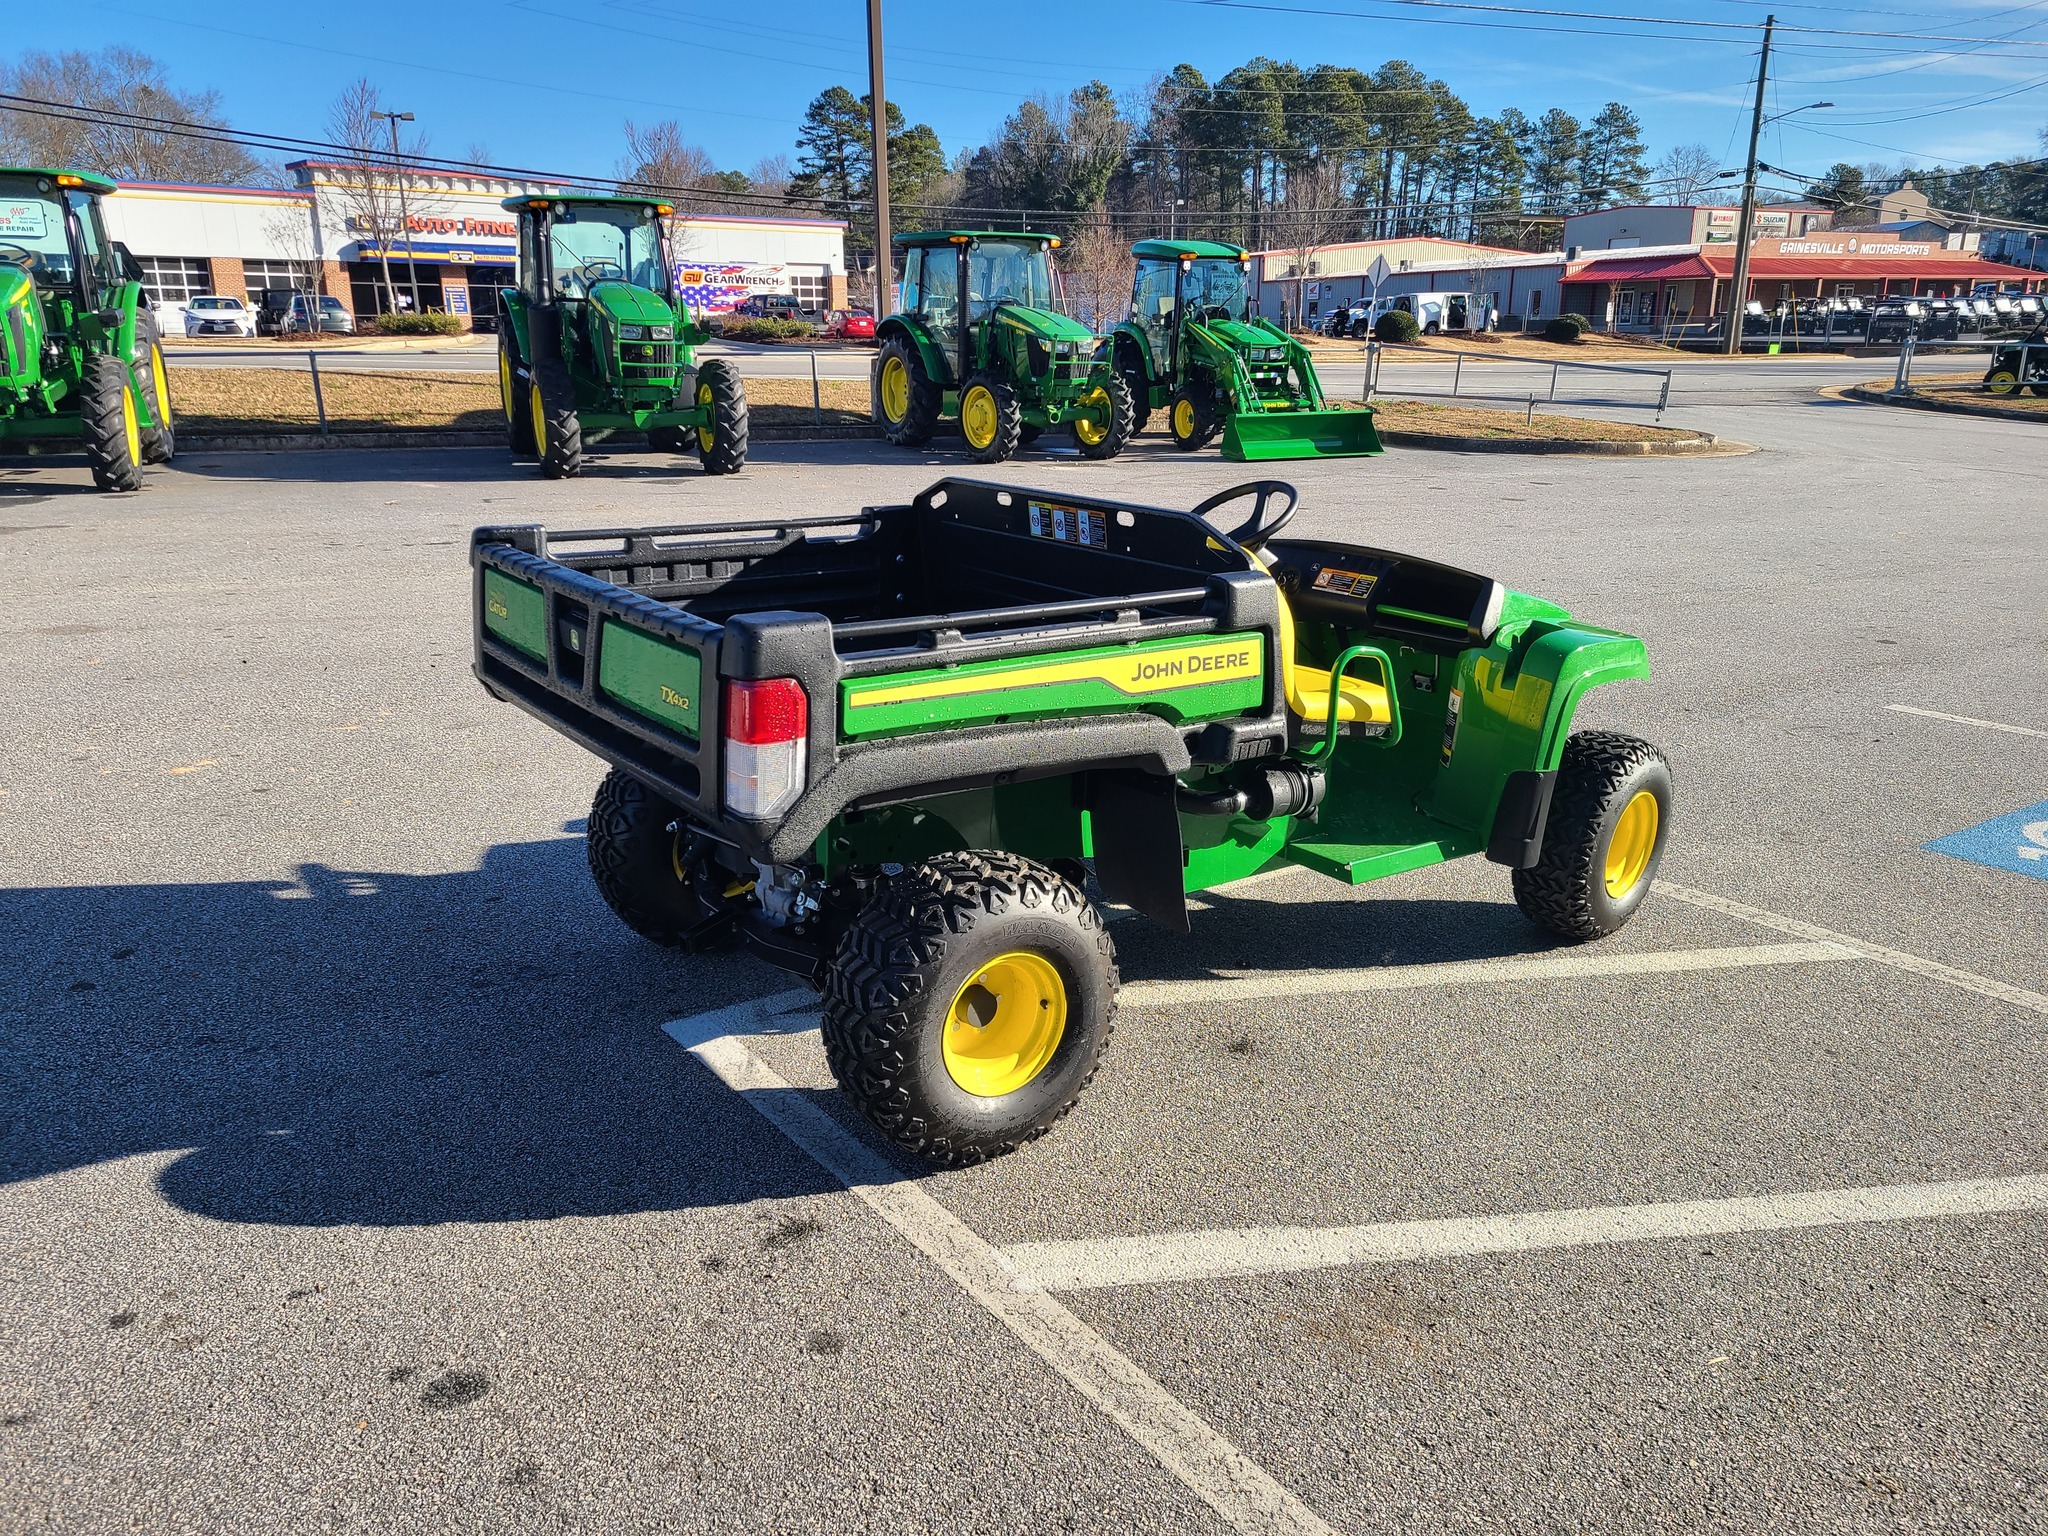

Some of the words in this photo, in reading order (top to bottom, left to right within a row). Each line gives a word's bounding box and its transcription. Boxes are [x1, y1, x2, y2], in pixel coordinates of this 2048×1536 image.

[406, 214, 457, 232] AUTO
[1779, 242, 1845, 255] GAINESVILLE
[1860, 243, 1931, 256] MOTORSPORTS
[704, 273, 779, 286] GEARWRENCH
[1131, 661, 1183, 682] JOHN
[1188, 651, 1250, 674] DEERE
[1003, 920, 1078, 949] WANDA
